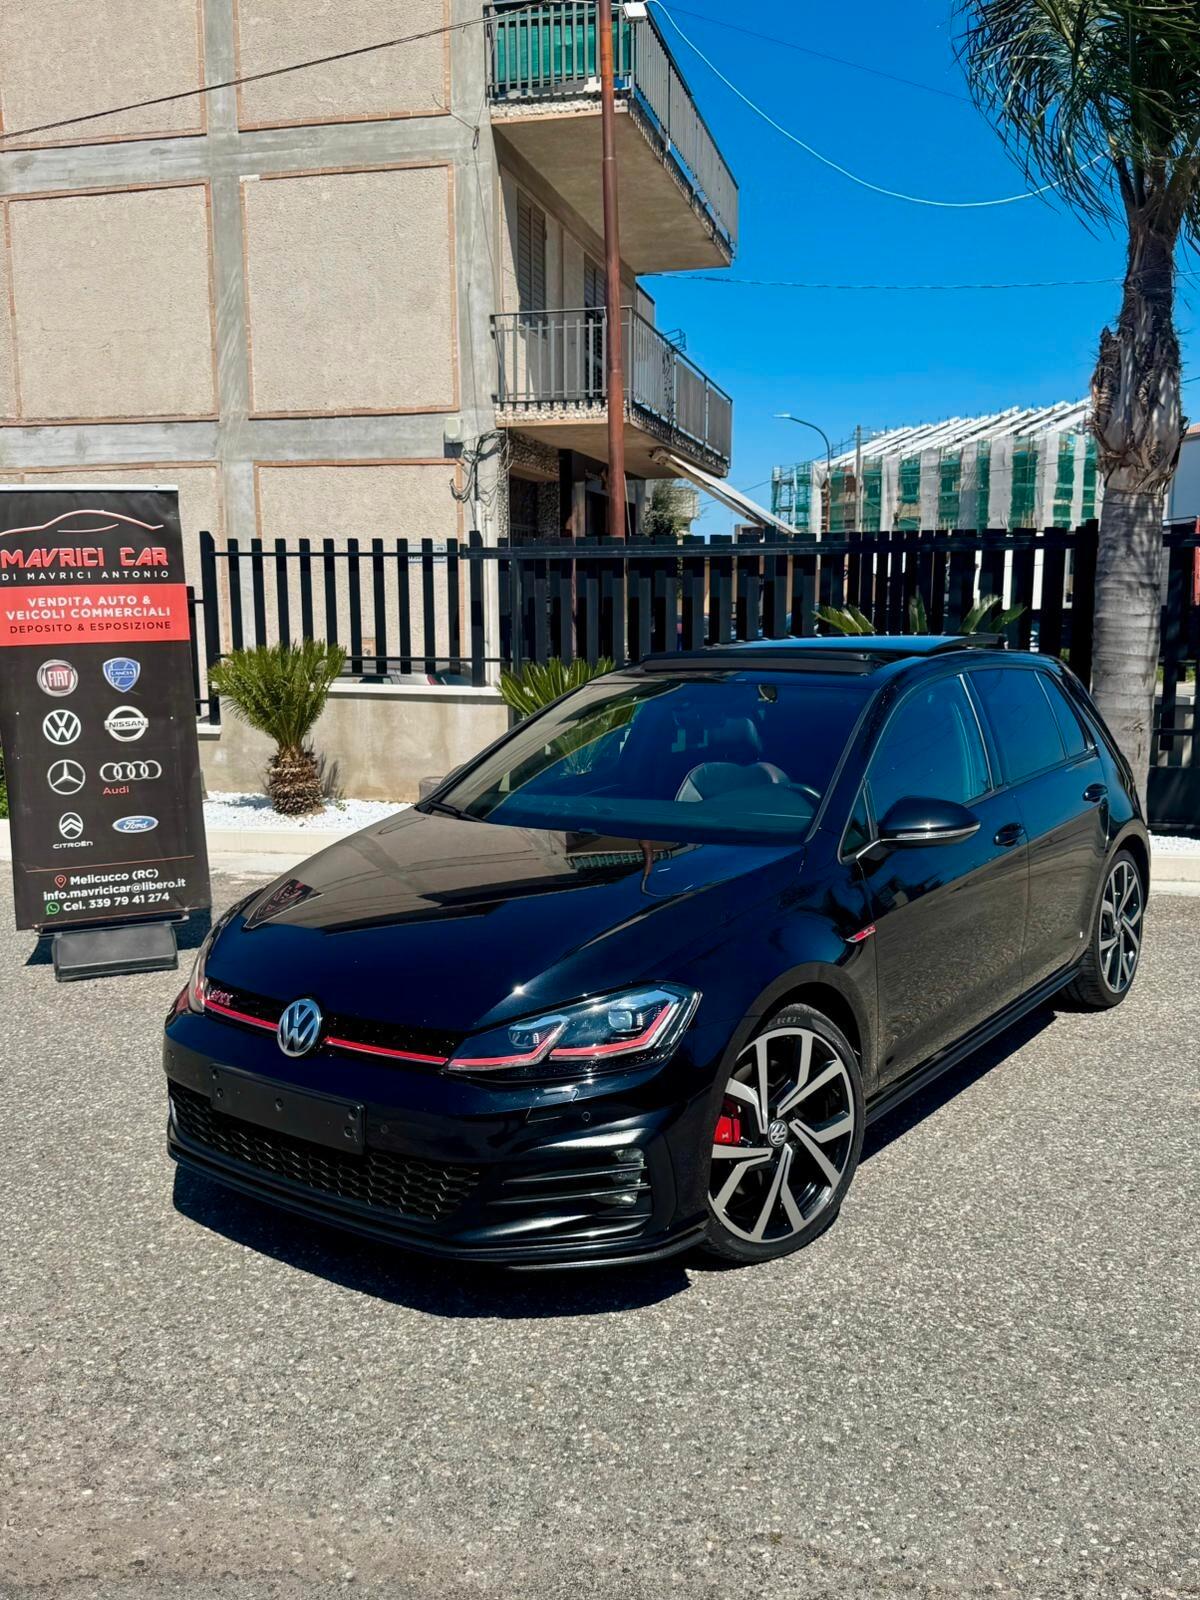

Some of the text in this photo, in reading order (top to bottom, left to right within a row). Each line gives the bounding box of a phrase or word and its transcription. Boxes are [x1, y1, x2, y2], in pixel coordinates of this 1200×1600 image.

[0, 547, 169, 569] MAVRICI CAR
[1, 570, 169, 581] DI MAVRICI ANTONIO
[27, 595, 152, 608] VENDITA AUTO &
[6, 607, 171, 620] VEICOLI COMMERCIALI
[9, 621, 171, 634] DEPOSITO & ESPOSIZIONE
[47, 670, 70, 687] FIAT
[108, 720, 145, 728] NISSAN
[102, 786, 130, 795] Audi
[123, 819, 148, 830] Ford
[70, 868, 159, 885] Melicucco (RC)
[43, 878, 187, 901] info.mavricicar@libero.it
[62, 892, 170, 911] Cel. 339 79 41 274
